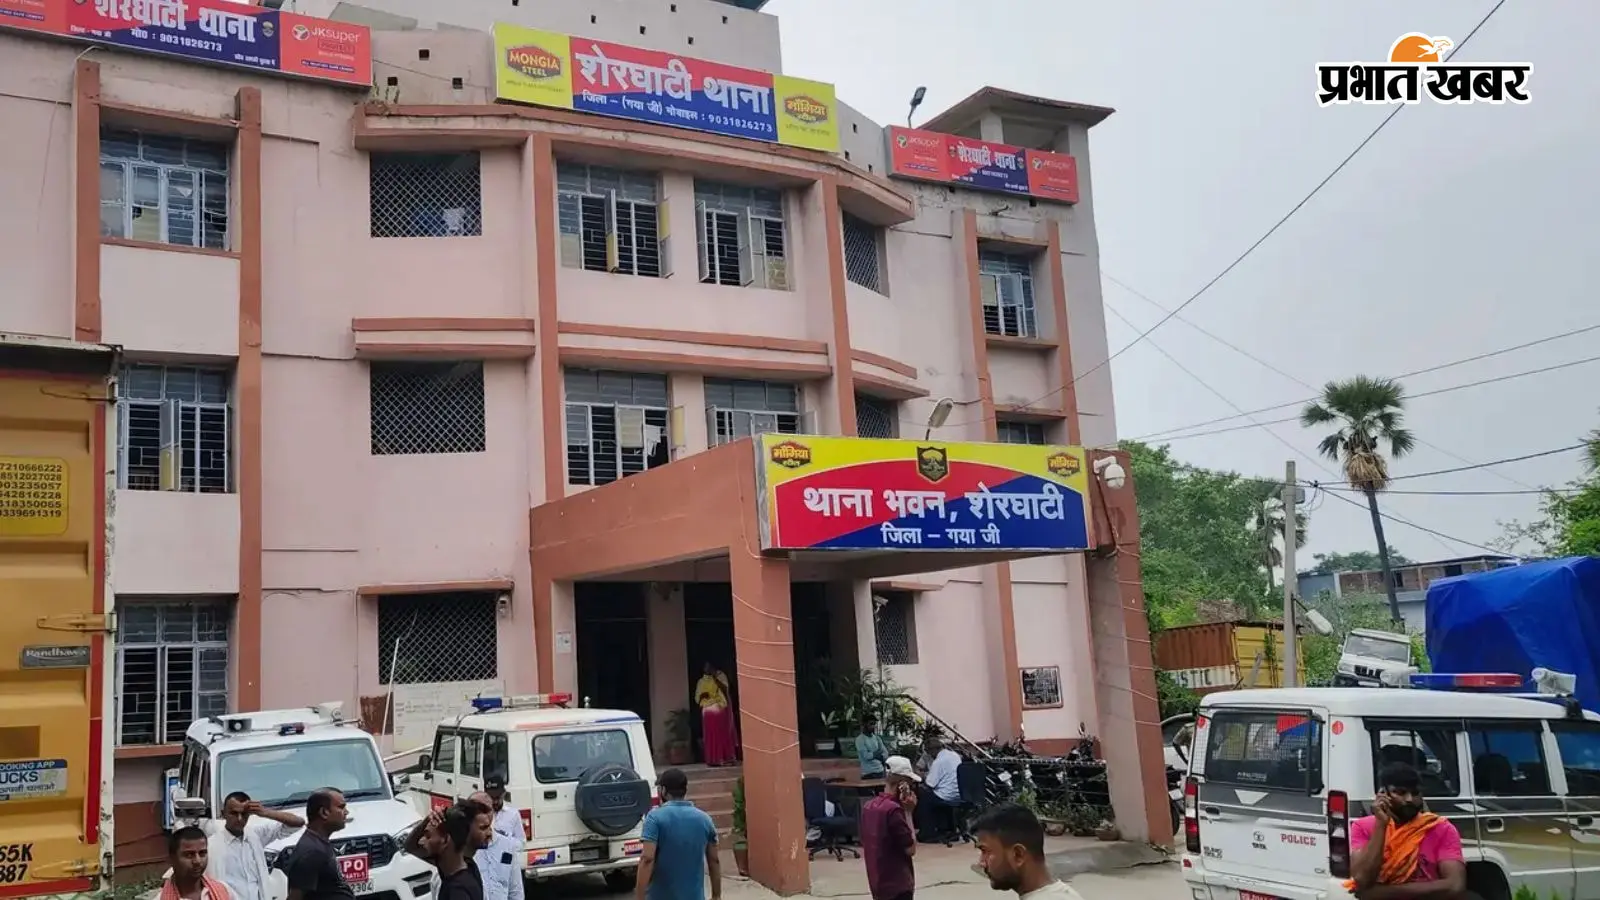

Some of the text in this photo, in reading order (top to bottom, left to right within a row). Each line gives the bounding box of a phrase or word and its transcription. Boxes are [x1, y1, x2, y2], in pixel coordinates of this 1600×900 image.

[198, 6, 257, 43] थाना
[159, 33, 222, 52] 9031826273
[509, 50, 560, 70] MONGIA
[521, 66, 547, 77] STEEL
[575, 43, 770, 116] शेरघाटी थाना
[582, 88, 607, 104] जिला
[621, 95, 644, 111] (गया
[647, 100, 663, 115] जी)
[666, 104, 698, 121] मोबाइल
[708, 114, 773, 134] 9031826273
[803, 480, 1065, 523] थाना भवन, शेरघाटी
[880, 522, 922, 544] जिला
[945, 527, 976, 545] गया
[980, 522, 1001, 545] जी
[37, 761, 56, 769] APP
[1280, 833, 1317, 847] POLICE
